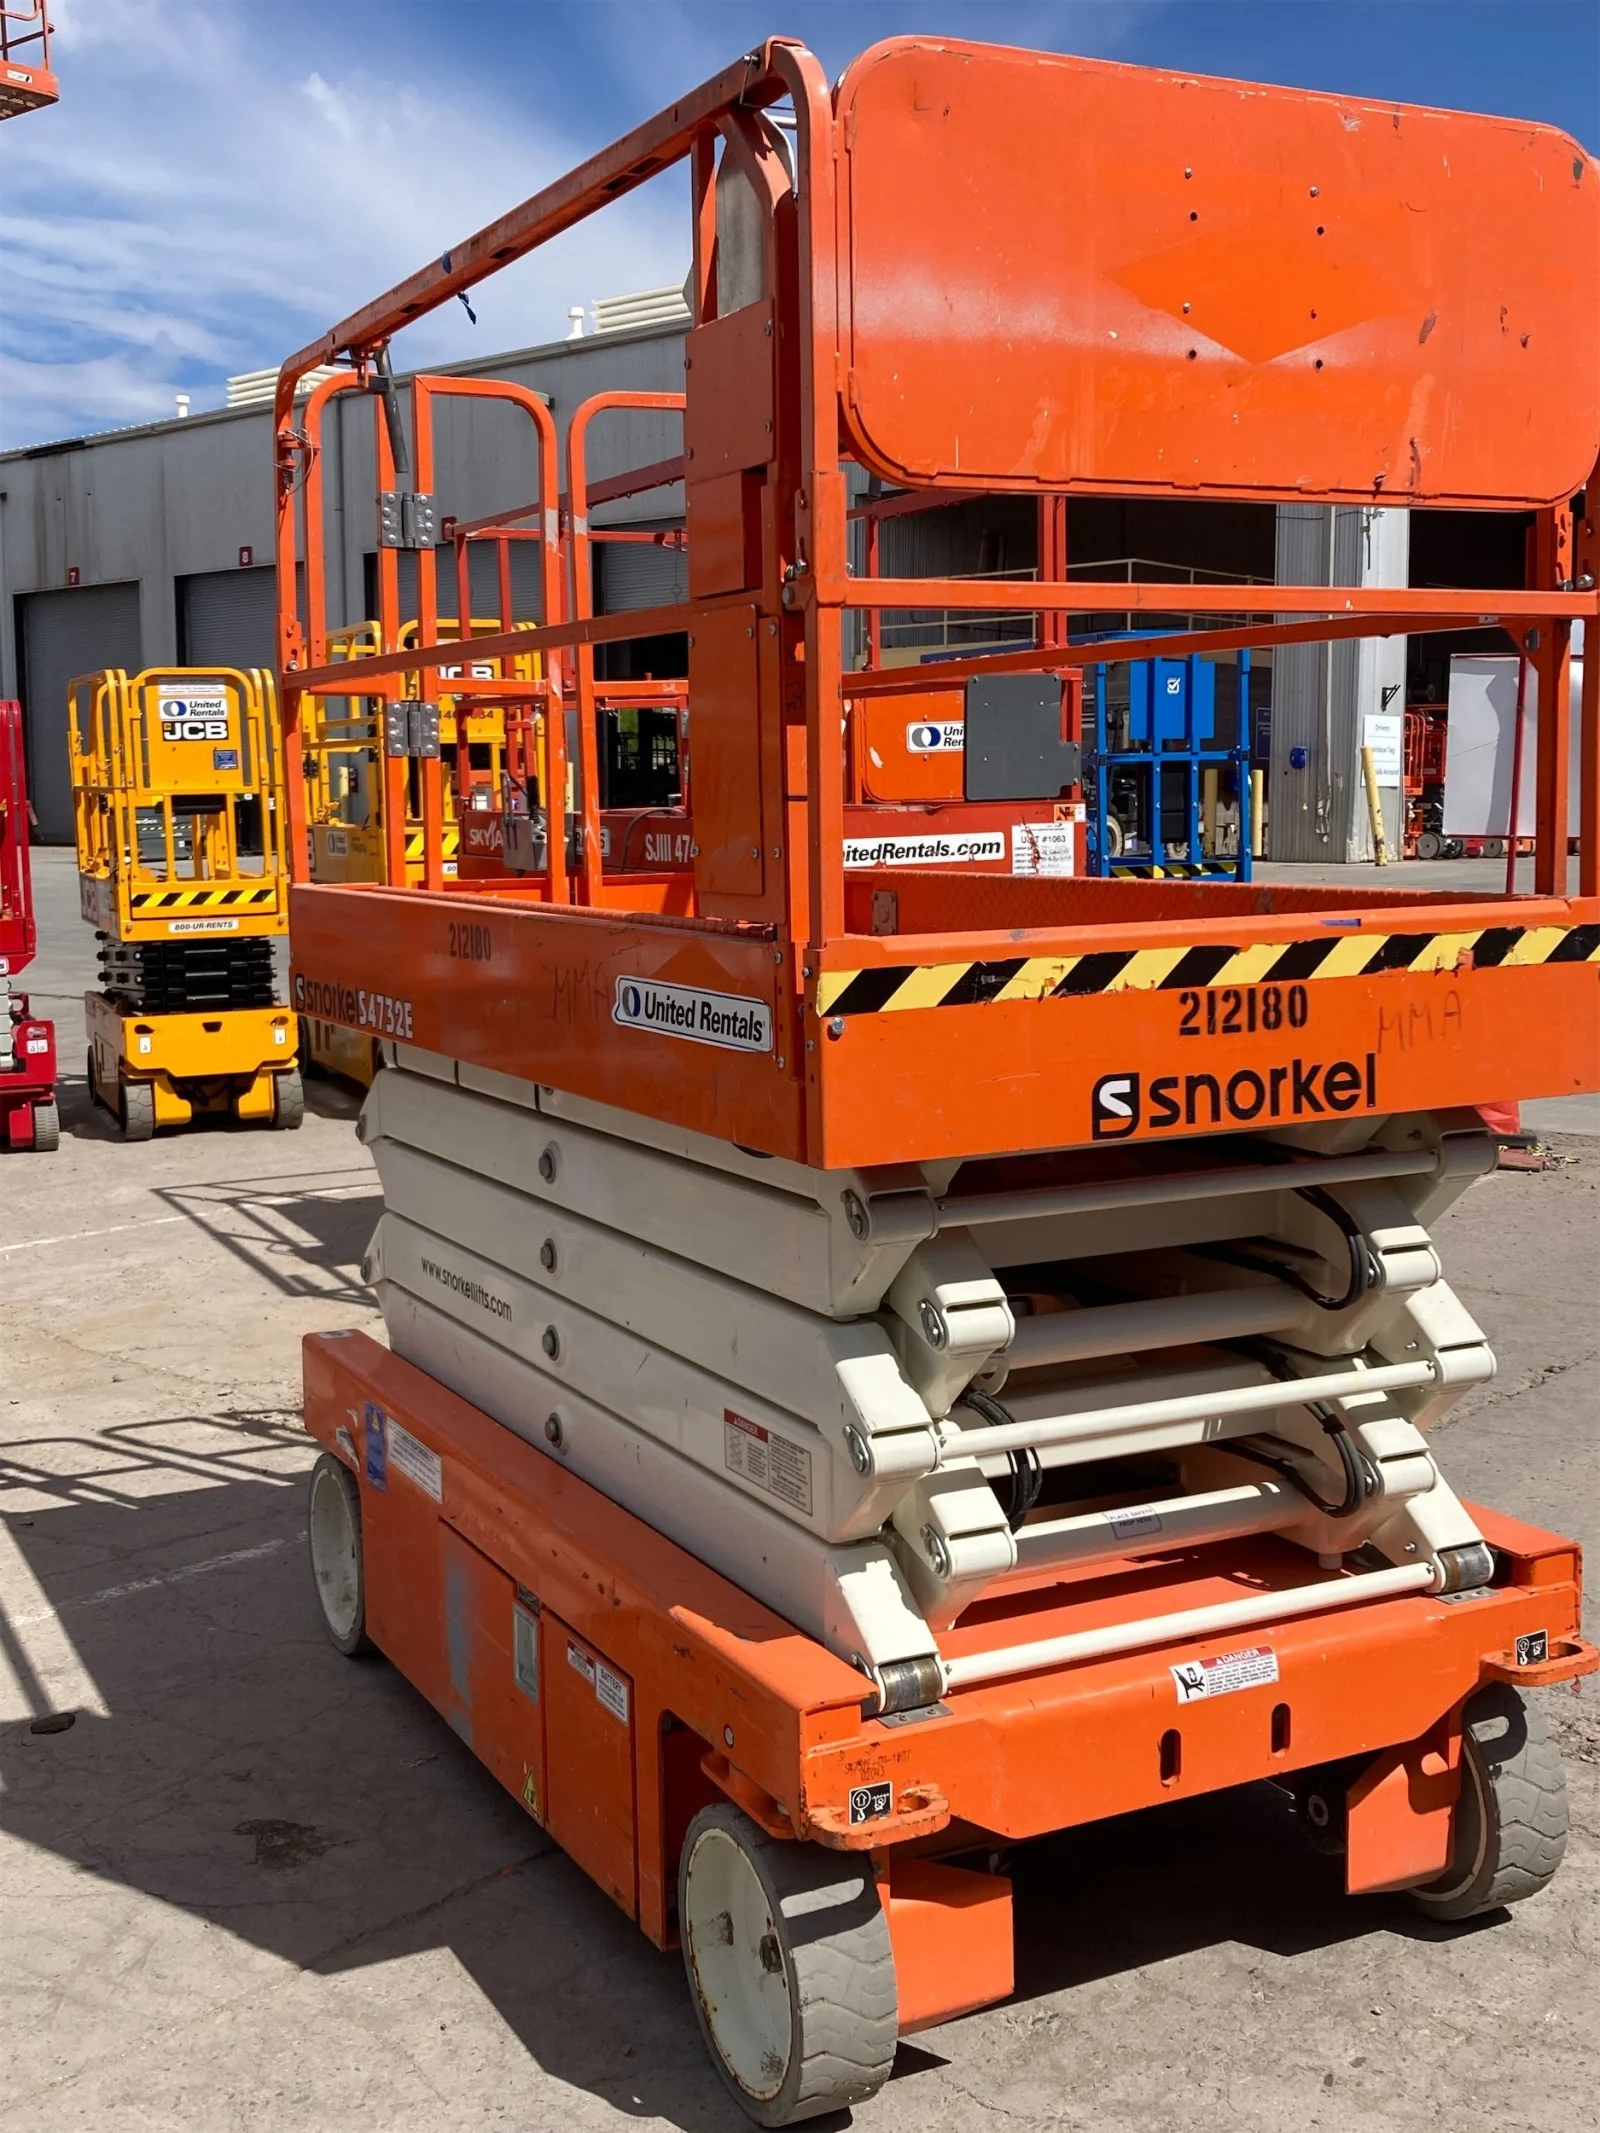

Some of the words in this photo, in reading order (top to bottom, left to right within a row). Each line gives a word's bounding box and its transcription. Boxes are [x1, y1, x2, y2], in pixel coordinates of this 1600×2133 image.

[242, 551, 249, 563] 8
[70, 572, 76, 582] 7
[189, 701, 222, 709] United
[189, 709, 225, 717] Rentals
[163, 722, 228, 740] JCB
[943, 726, 964, 736] Uni
[469, 820, 504, 851] SKYJA
[1042, 835, 1066, 843] #1063
[843, 839, 1001, 862] itedRentals.com
[174, 921, 234, 930] 800-UR-RENTS
[449, 922, 492, 961] 212180
[306, 980, 359, 1024] snorkel
[358, 990, 413, 1040] S4732E
[643, 991, 697, 1029] United
[699, 1001, 764, 1043] Rentals
[1179, 984, 1309, 1037] 212180
[1149, 1052, 1377, 1129] snorkel
[421, 1256, 513, 1322] www.snorkellifts.com
[1222, 1648, 1261, 1665] DANGER
